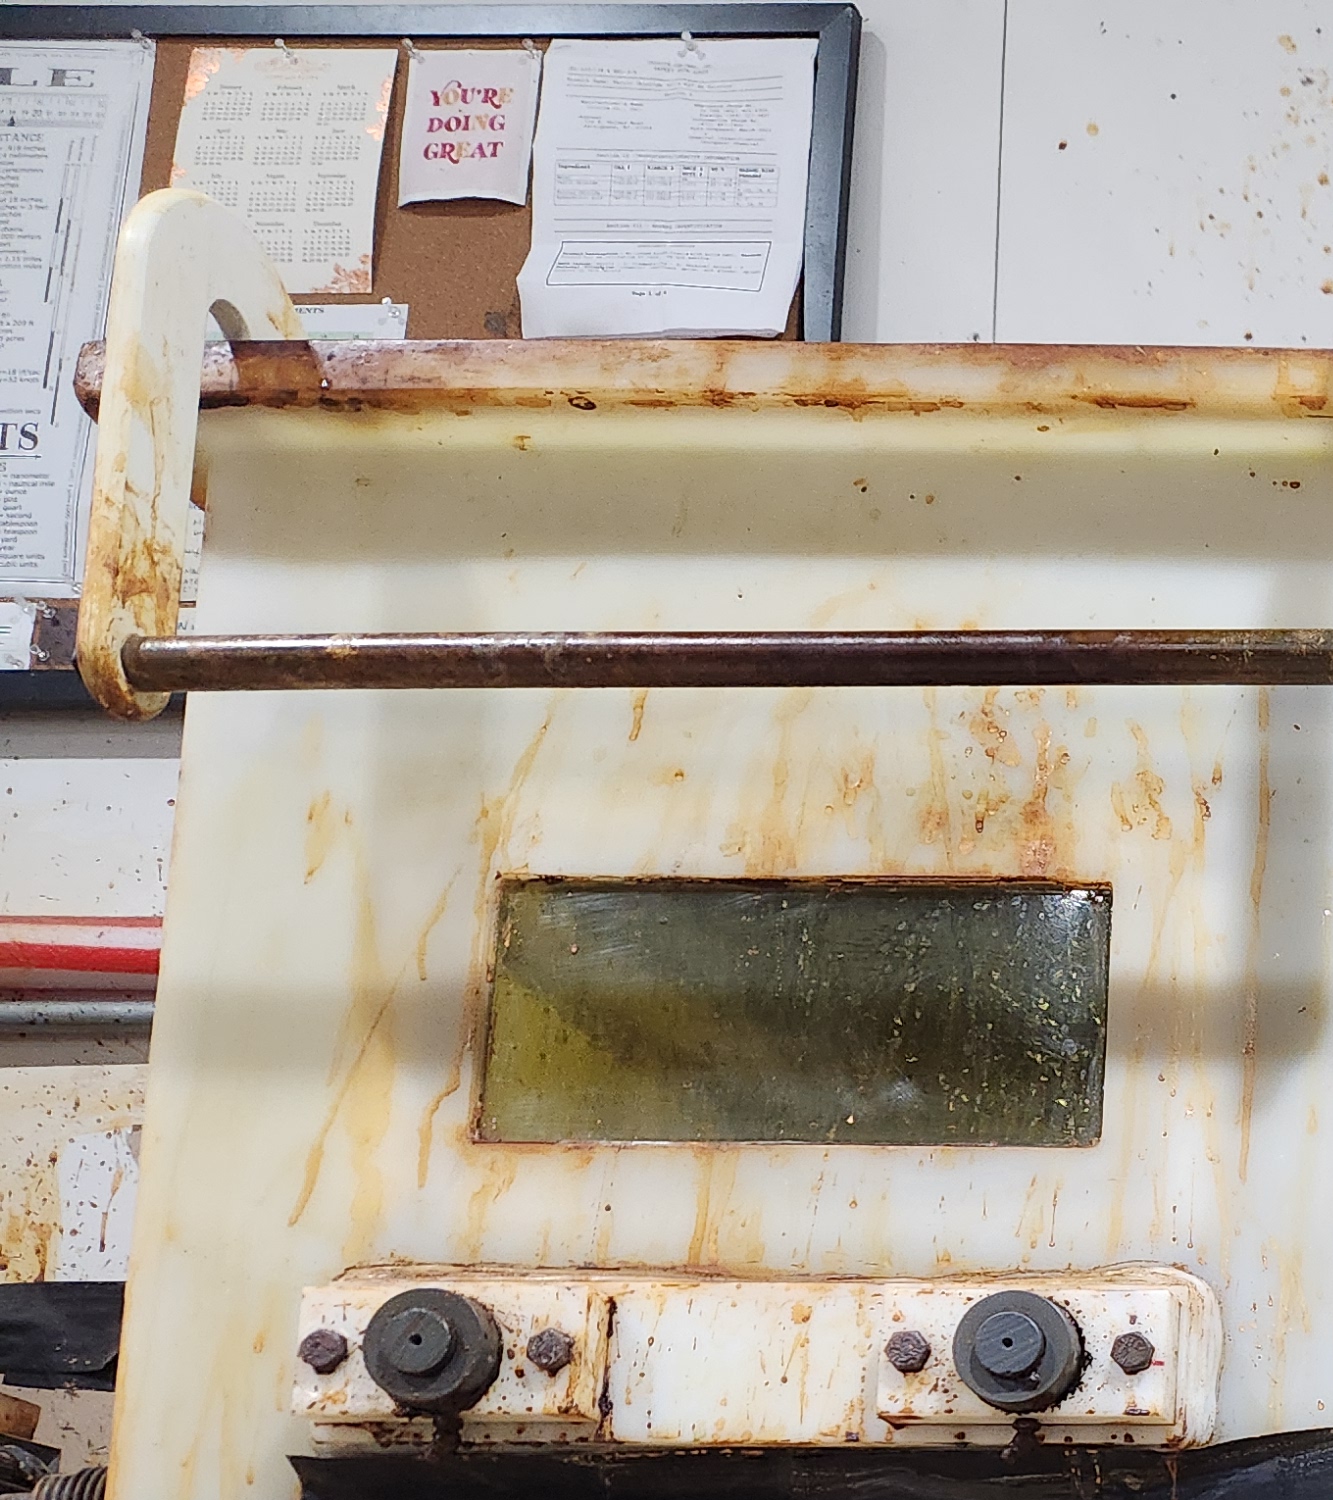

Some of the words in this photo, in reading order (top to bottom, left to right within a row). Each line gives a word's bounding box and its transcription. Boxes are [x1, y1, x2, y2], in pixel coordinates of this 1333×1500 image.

[430, 80, 514, 109] YOU'RE
[427, 114, 505, 133] DOING
[423, 141, 504, 164] GREAT
